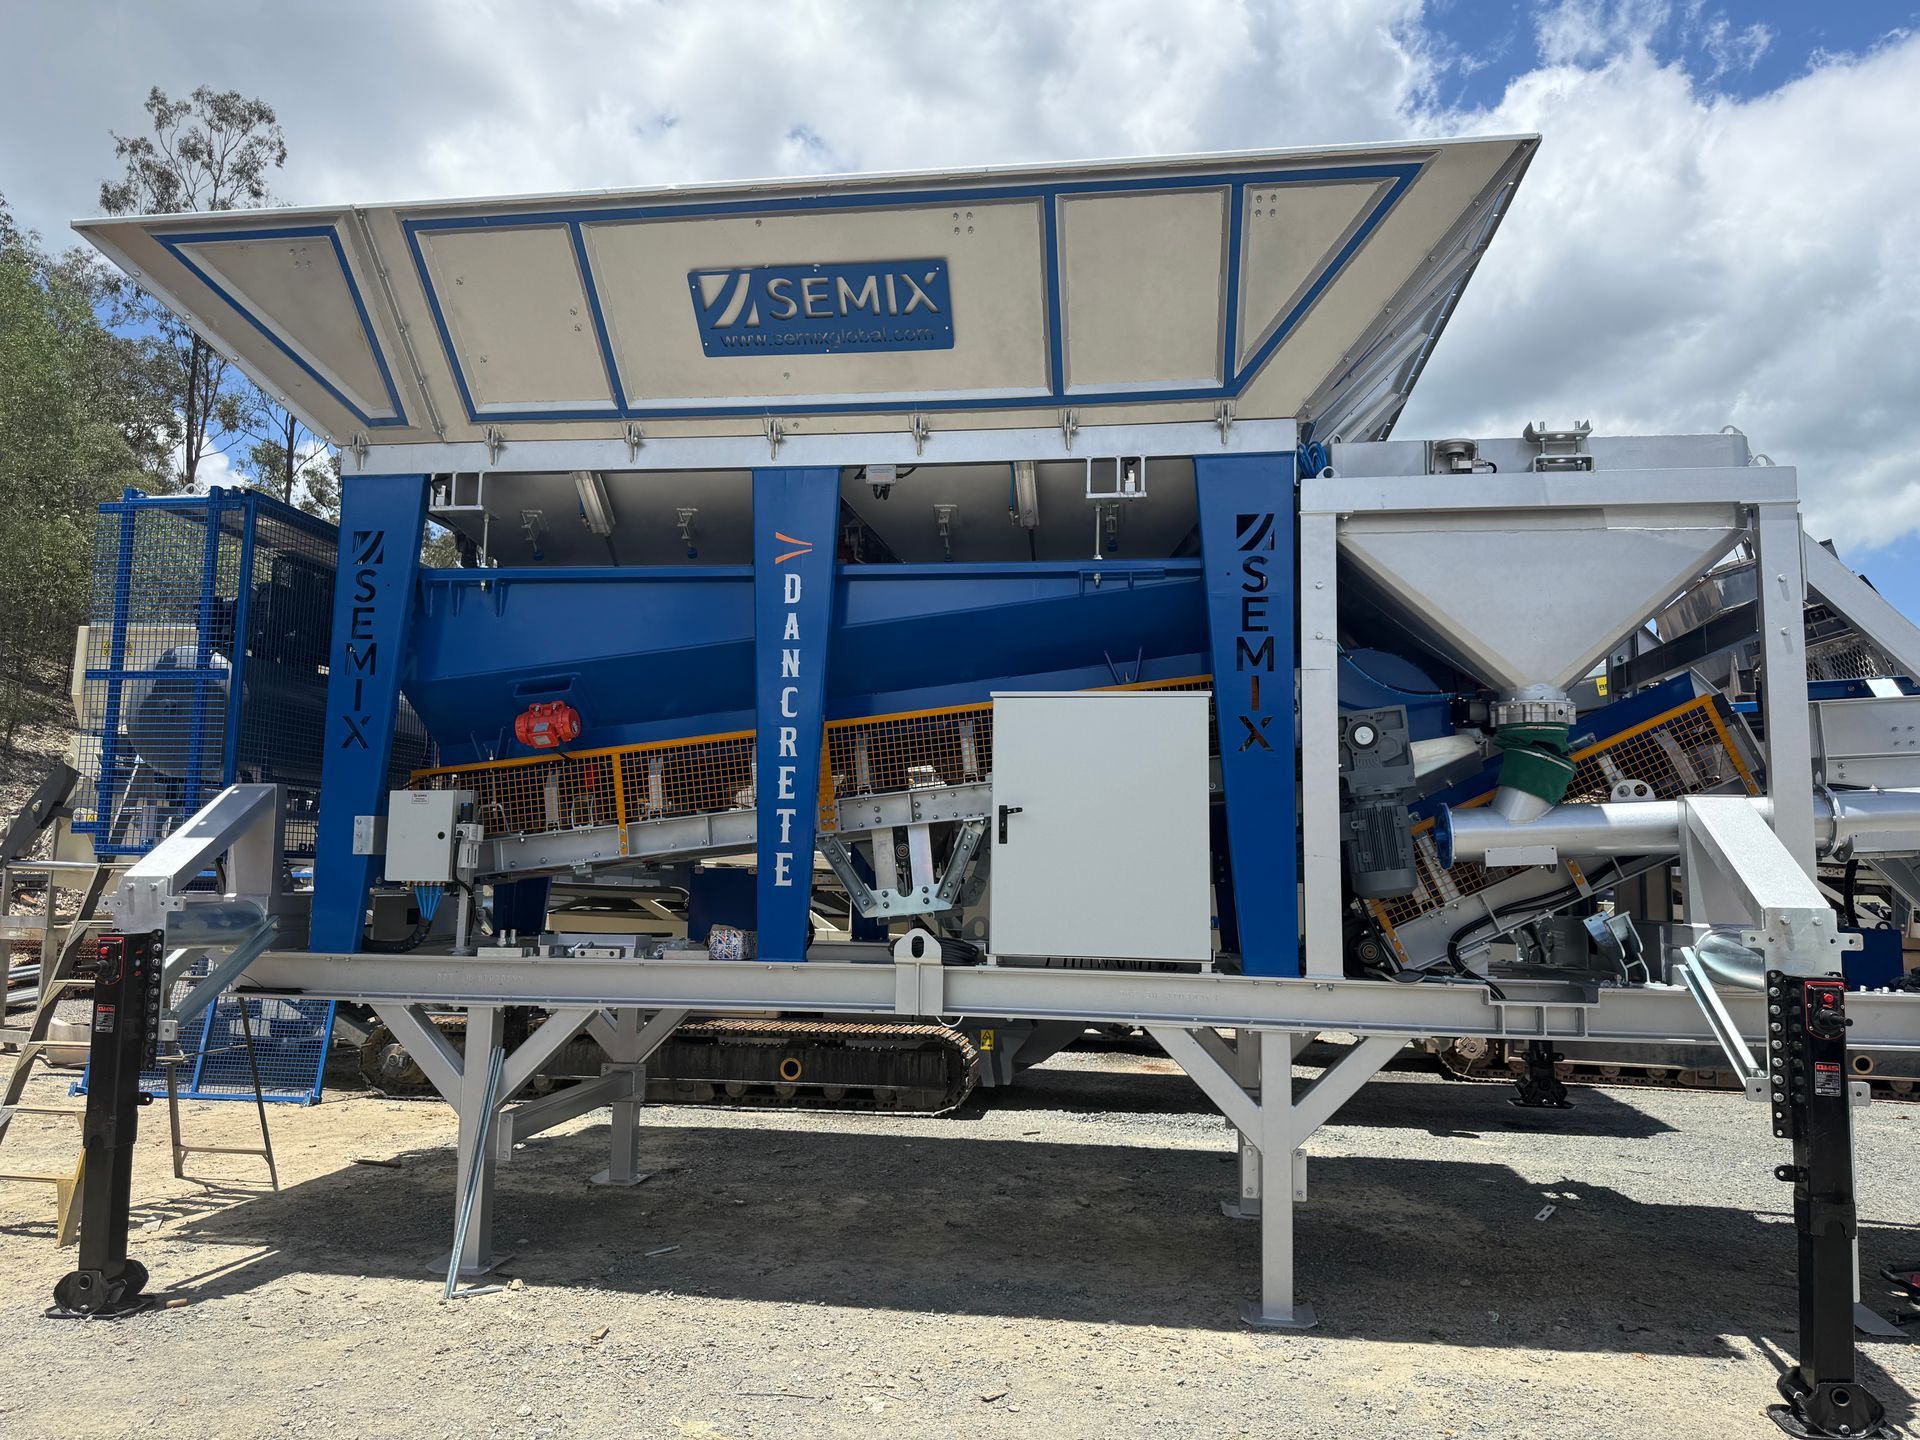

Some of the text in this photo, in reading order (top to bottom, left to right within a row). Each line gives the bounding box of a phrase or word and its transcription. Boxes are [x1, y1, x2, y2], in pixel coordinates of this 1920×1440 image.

[719, 327, 936, 348] www.semixglobal.com
[766, 271, 942, 321] SEMIX
[341, 568, 377, 750] SEMIX
[774, 573, 802, 887] DANCRETE
[1235, 555, 1275, 752] SEMIX
